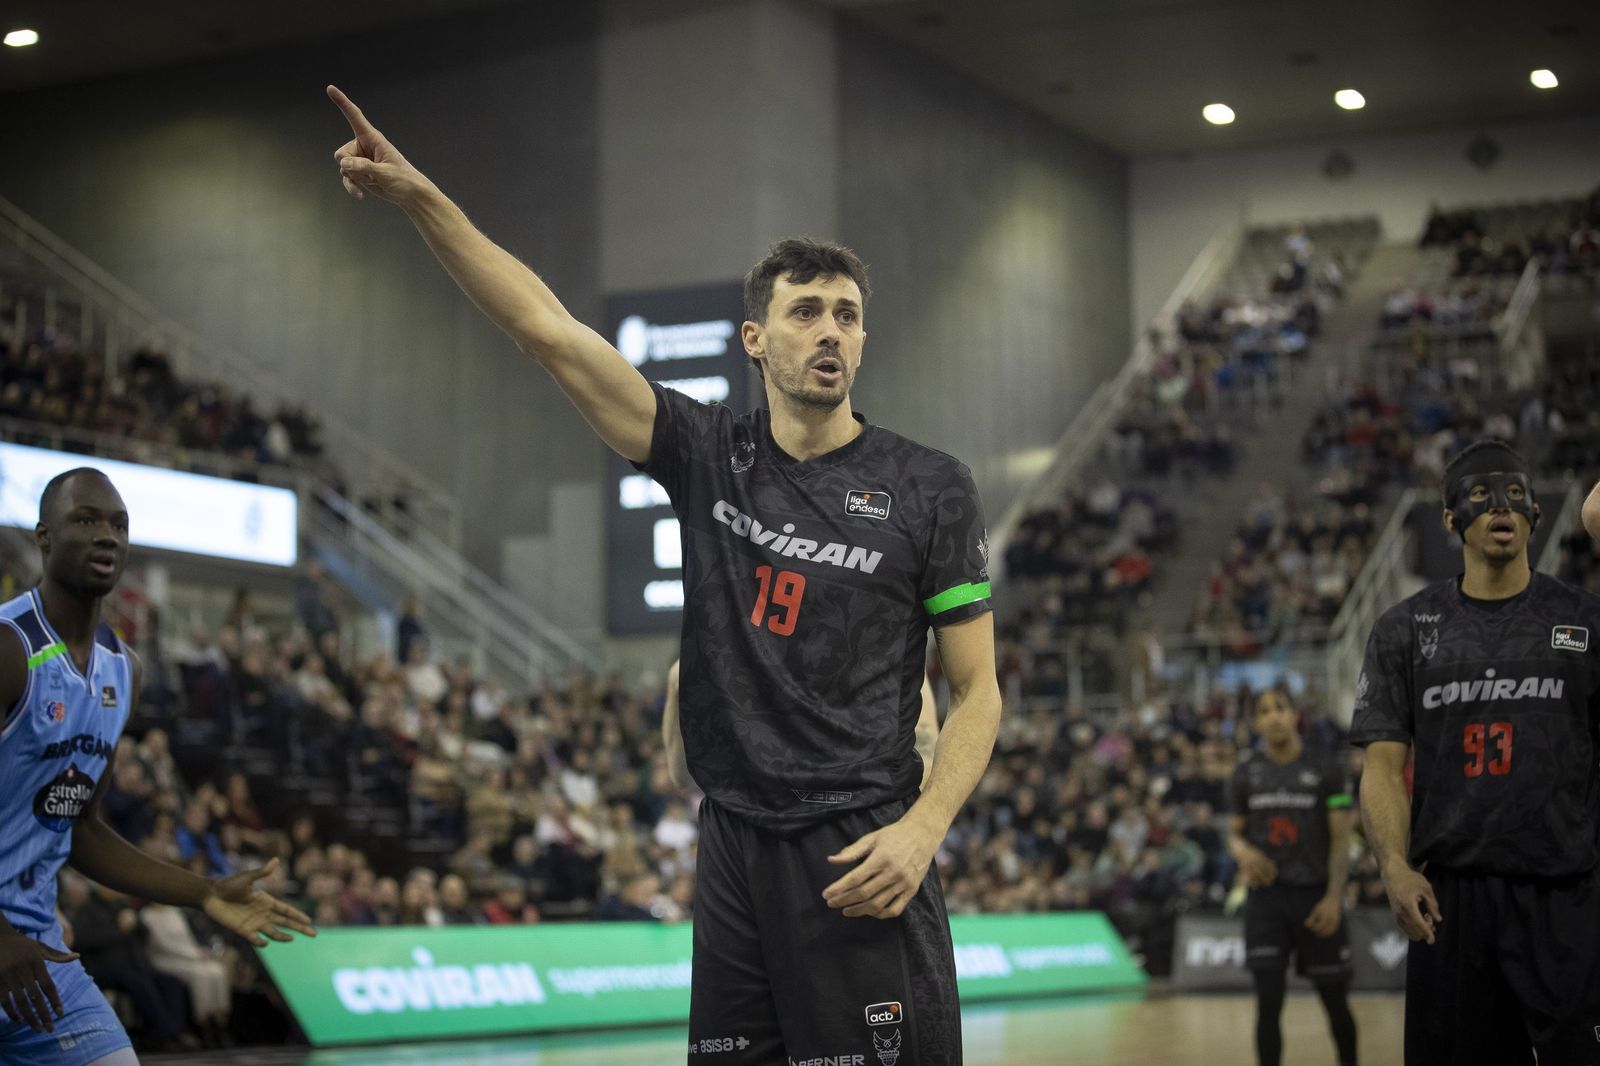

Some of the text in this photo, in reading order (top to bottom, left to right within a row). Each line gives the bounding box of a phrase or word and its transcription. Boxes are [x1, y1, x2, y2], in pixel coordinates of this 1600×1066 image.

[849, 504, 885, 515] endesa
[850, 495, 868, 505] liga
[712, 499, 884, 575] COVIRAN
[750, 565, 806, 637] 19
[1422, 667, 1565, 710] COVIRAN
[1463, 721, 1513, 777] 93
[870, 1011, 894, 1023] acb
[700, 1037, 734, 1053] asisa
